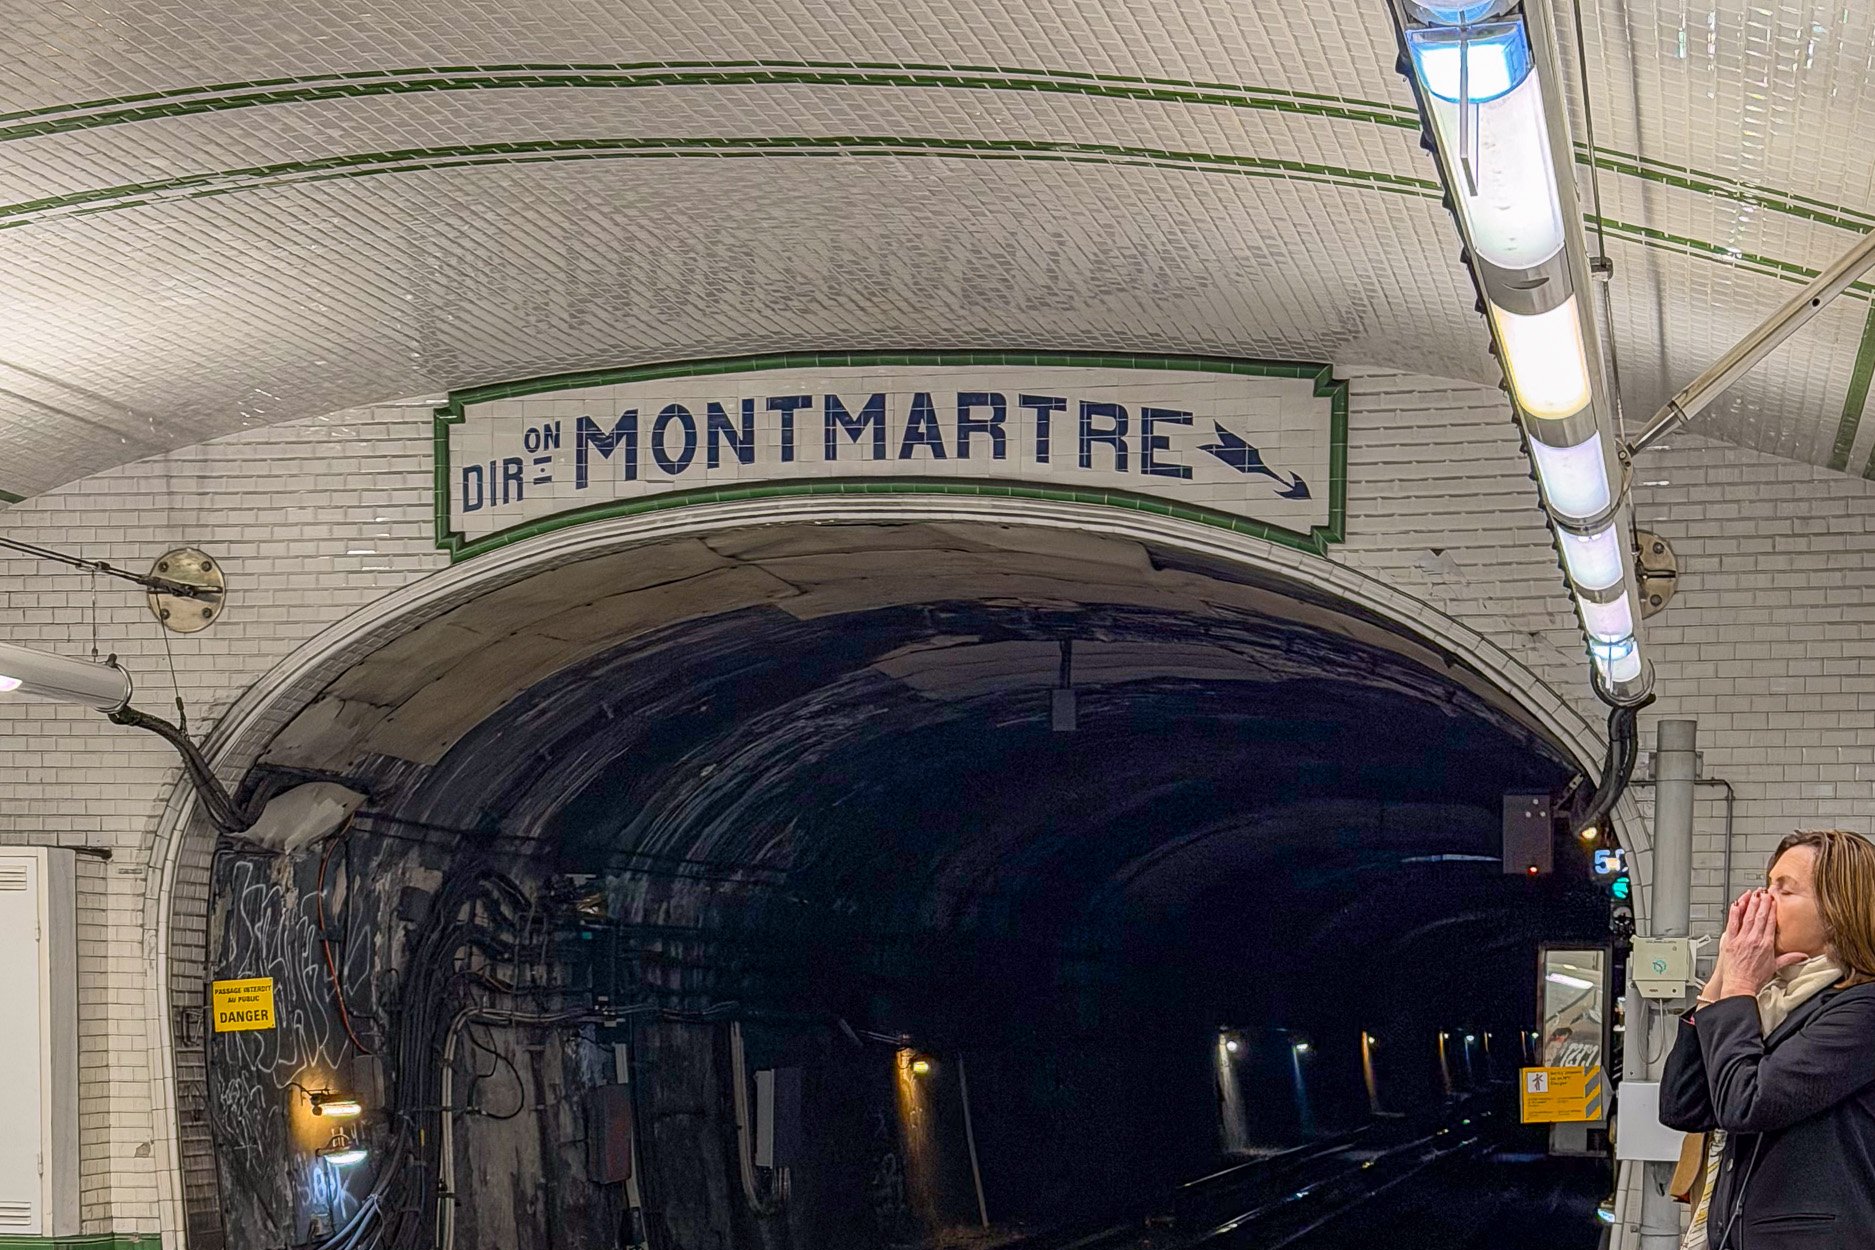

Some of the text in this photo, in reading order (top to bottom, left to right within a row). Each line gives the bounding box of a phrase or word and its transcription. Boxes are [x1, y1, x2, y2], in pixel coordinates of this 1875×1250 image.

[576, 392, 1194, 490] MONTMARTRE
[215, 985, 272, 995] PASSAGE INTERDIT
[238, 995, 260, 1003] PUBLIC
[220, 1010, 269, 1023] DANGER
